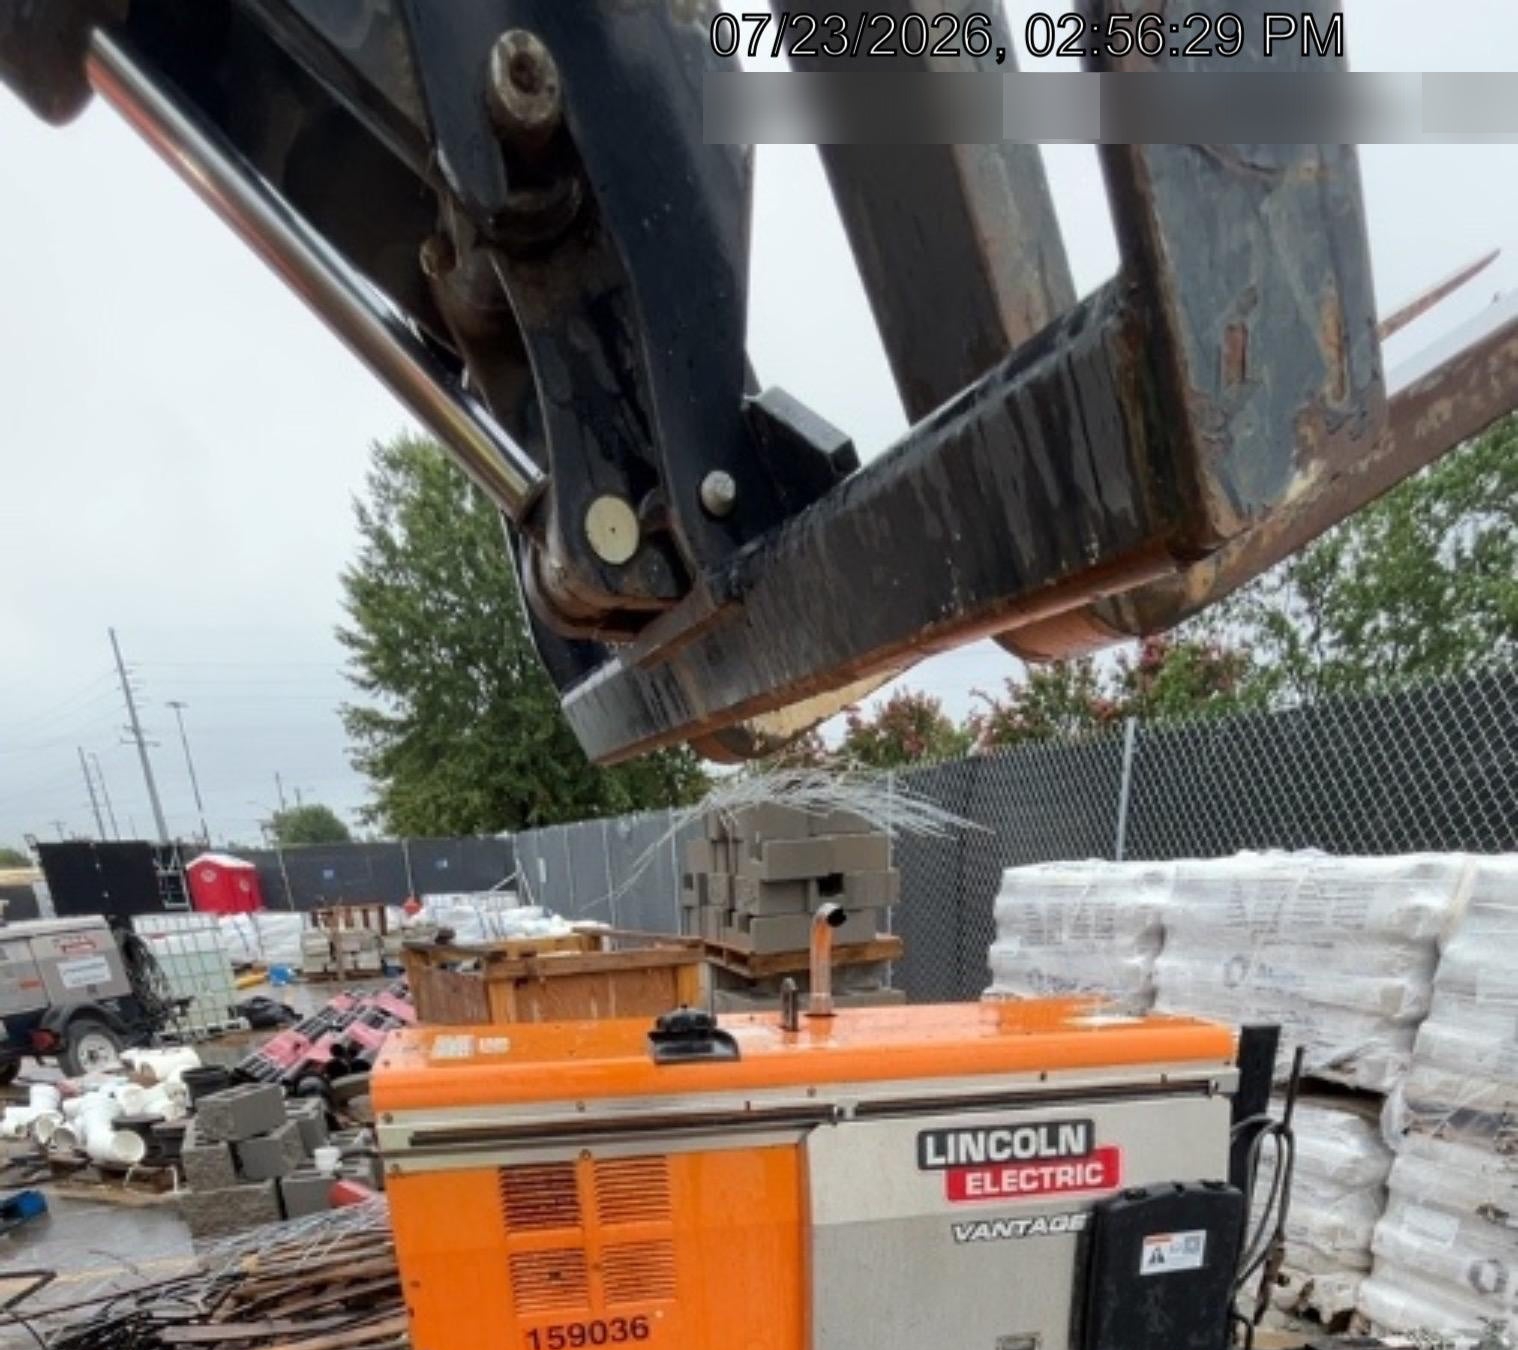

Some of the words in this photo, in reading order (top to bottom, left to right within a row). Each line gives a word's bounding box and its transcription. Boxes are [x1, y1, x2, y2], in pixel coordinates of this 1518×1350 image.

[925, 1123, 1088, 1166] LINCOLN
[964, 1161, 1105, 1196] ELECTRIC
[952, 1211, 1089, 1243] VANTAGE
